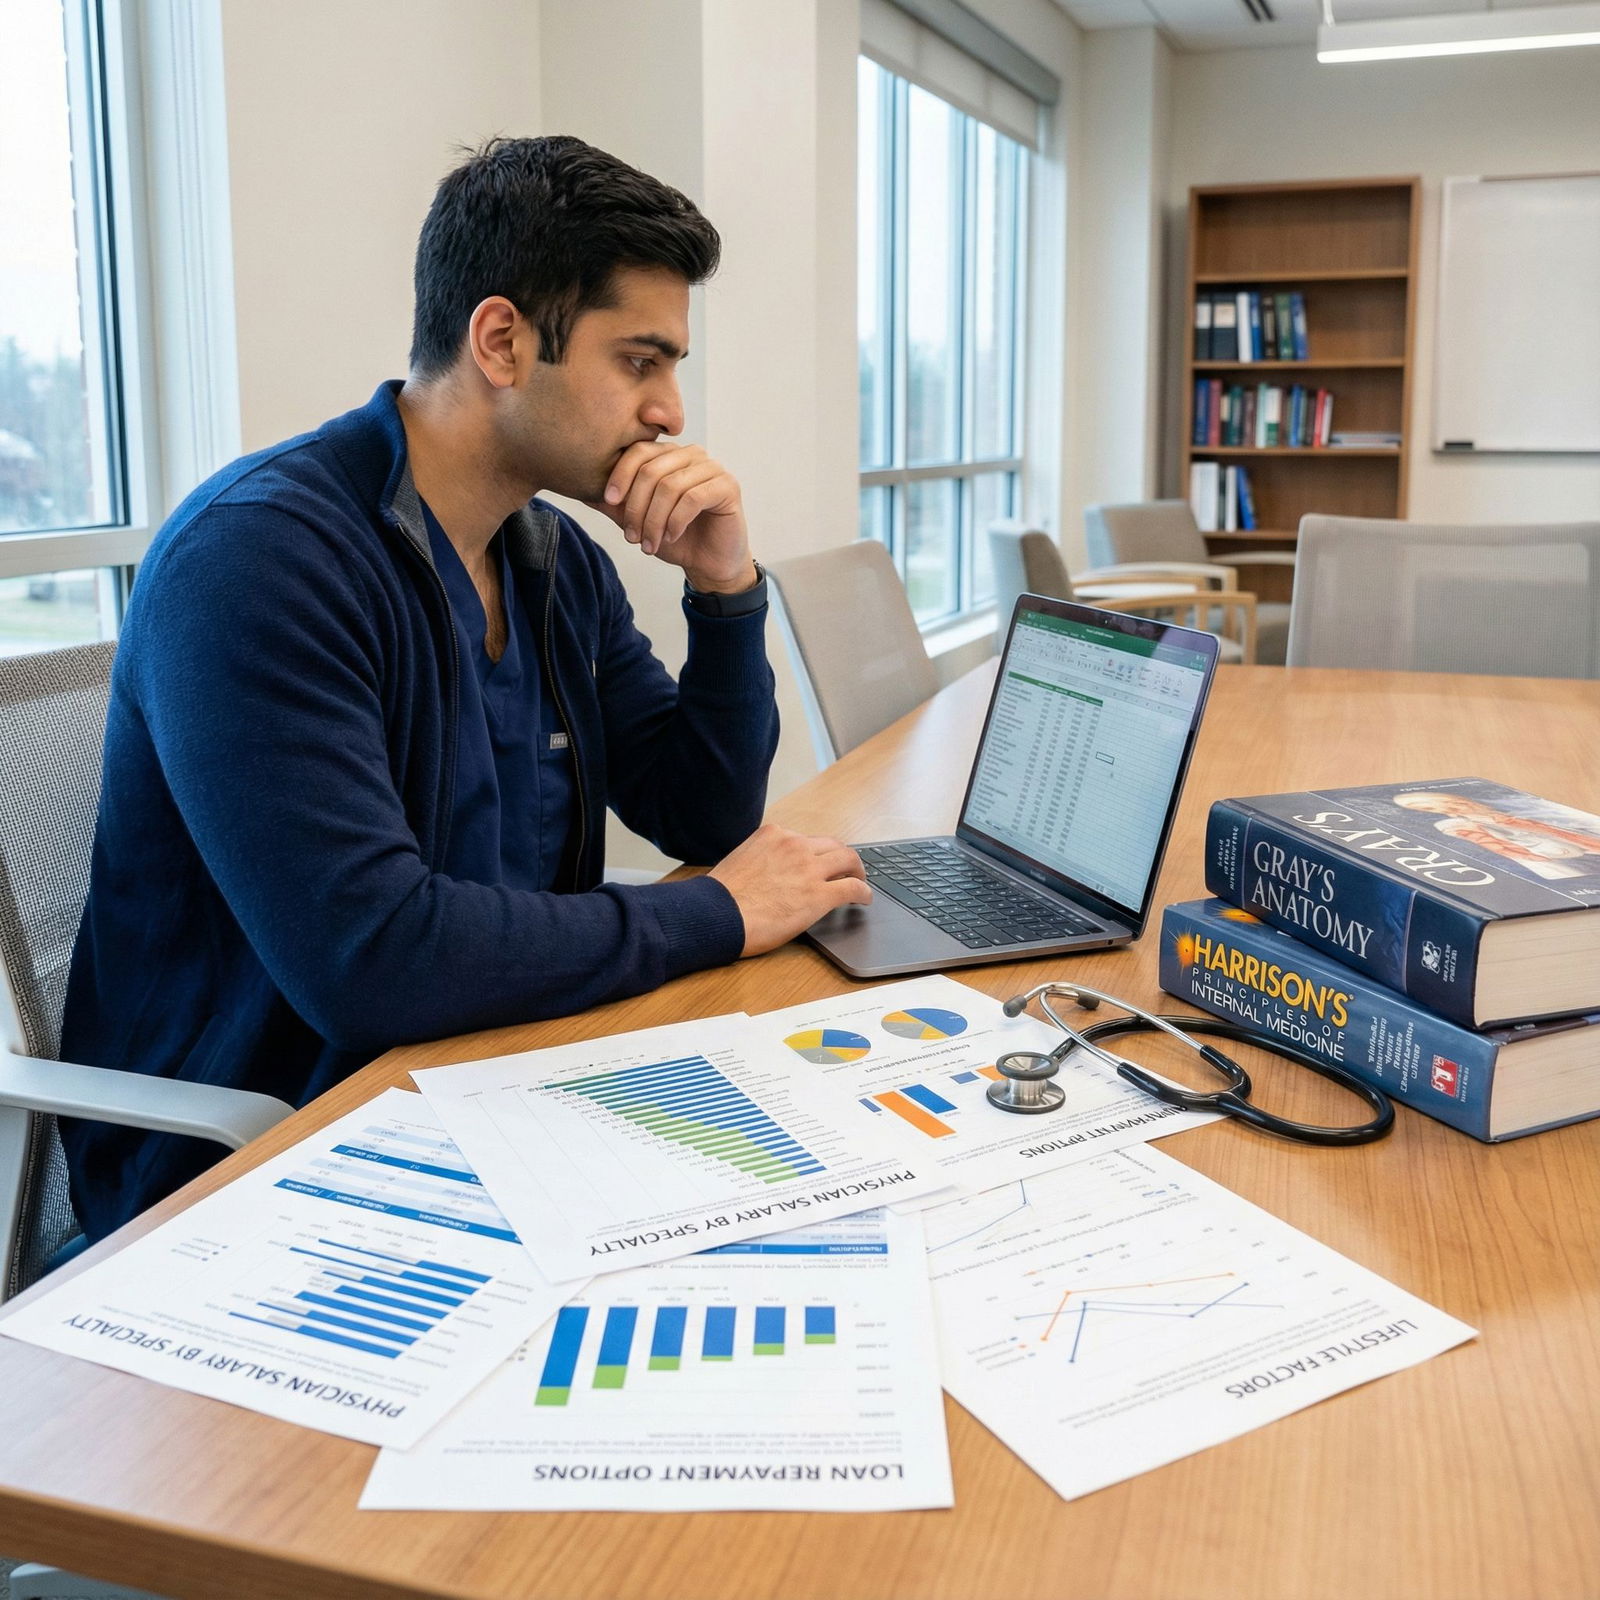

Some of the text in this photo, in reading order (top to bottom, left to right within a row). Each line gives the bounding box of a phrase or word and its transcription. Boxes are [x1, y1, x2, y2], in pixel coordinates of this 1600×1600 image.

[1253, 841, 1336, 901] GRAY'S
[1294, 811, 1496, 887] GRAY'S
[1252, 876, 1374, 959] ANATOMY
[1191, 980, 1263, 1025] INTERNAL
[1266, 1018, 1345, 1062] MEDICINE
[1192, 967, 1345, 1045] PRINCIPLES OF
[589, 1170, 916, 1257] PHYSICIAN SALARY BY SPECIALTY
[61, 1313, 406, 1418] PHYSICIAN SALARY BY SPECIALTY
[1224, 1319, 1418, 1400] LIFESTYLE FACTORS
[532, 1463, 904, 1481] LOAN REPAYMENT OPTIONS
